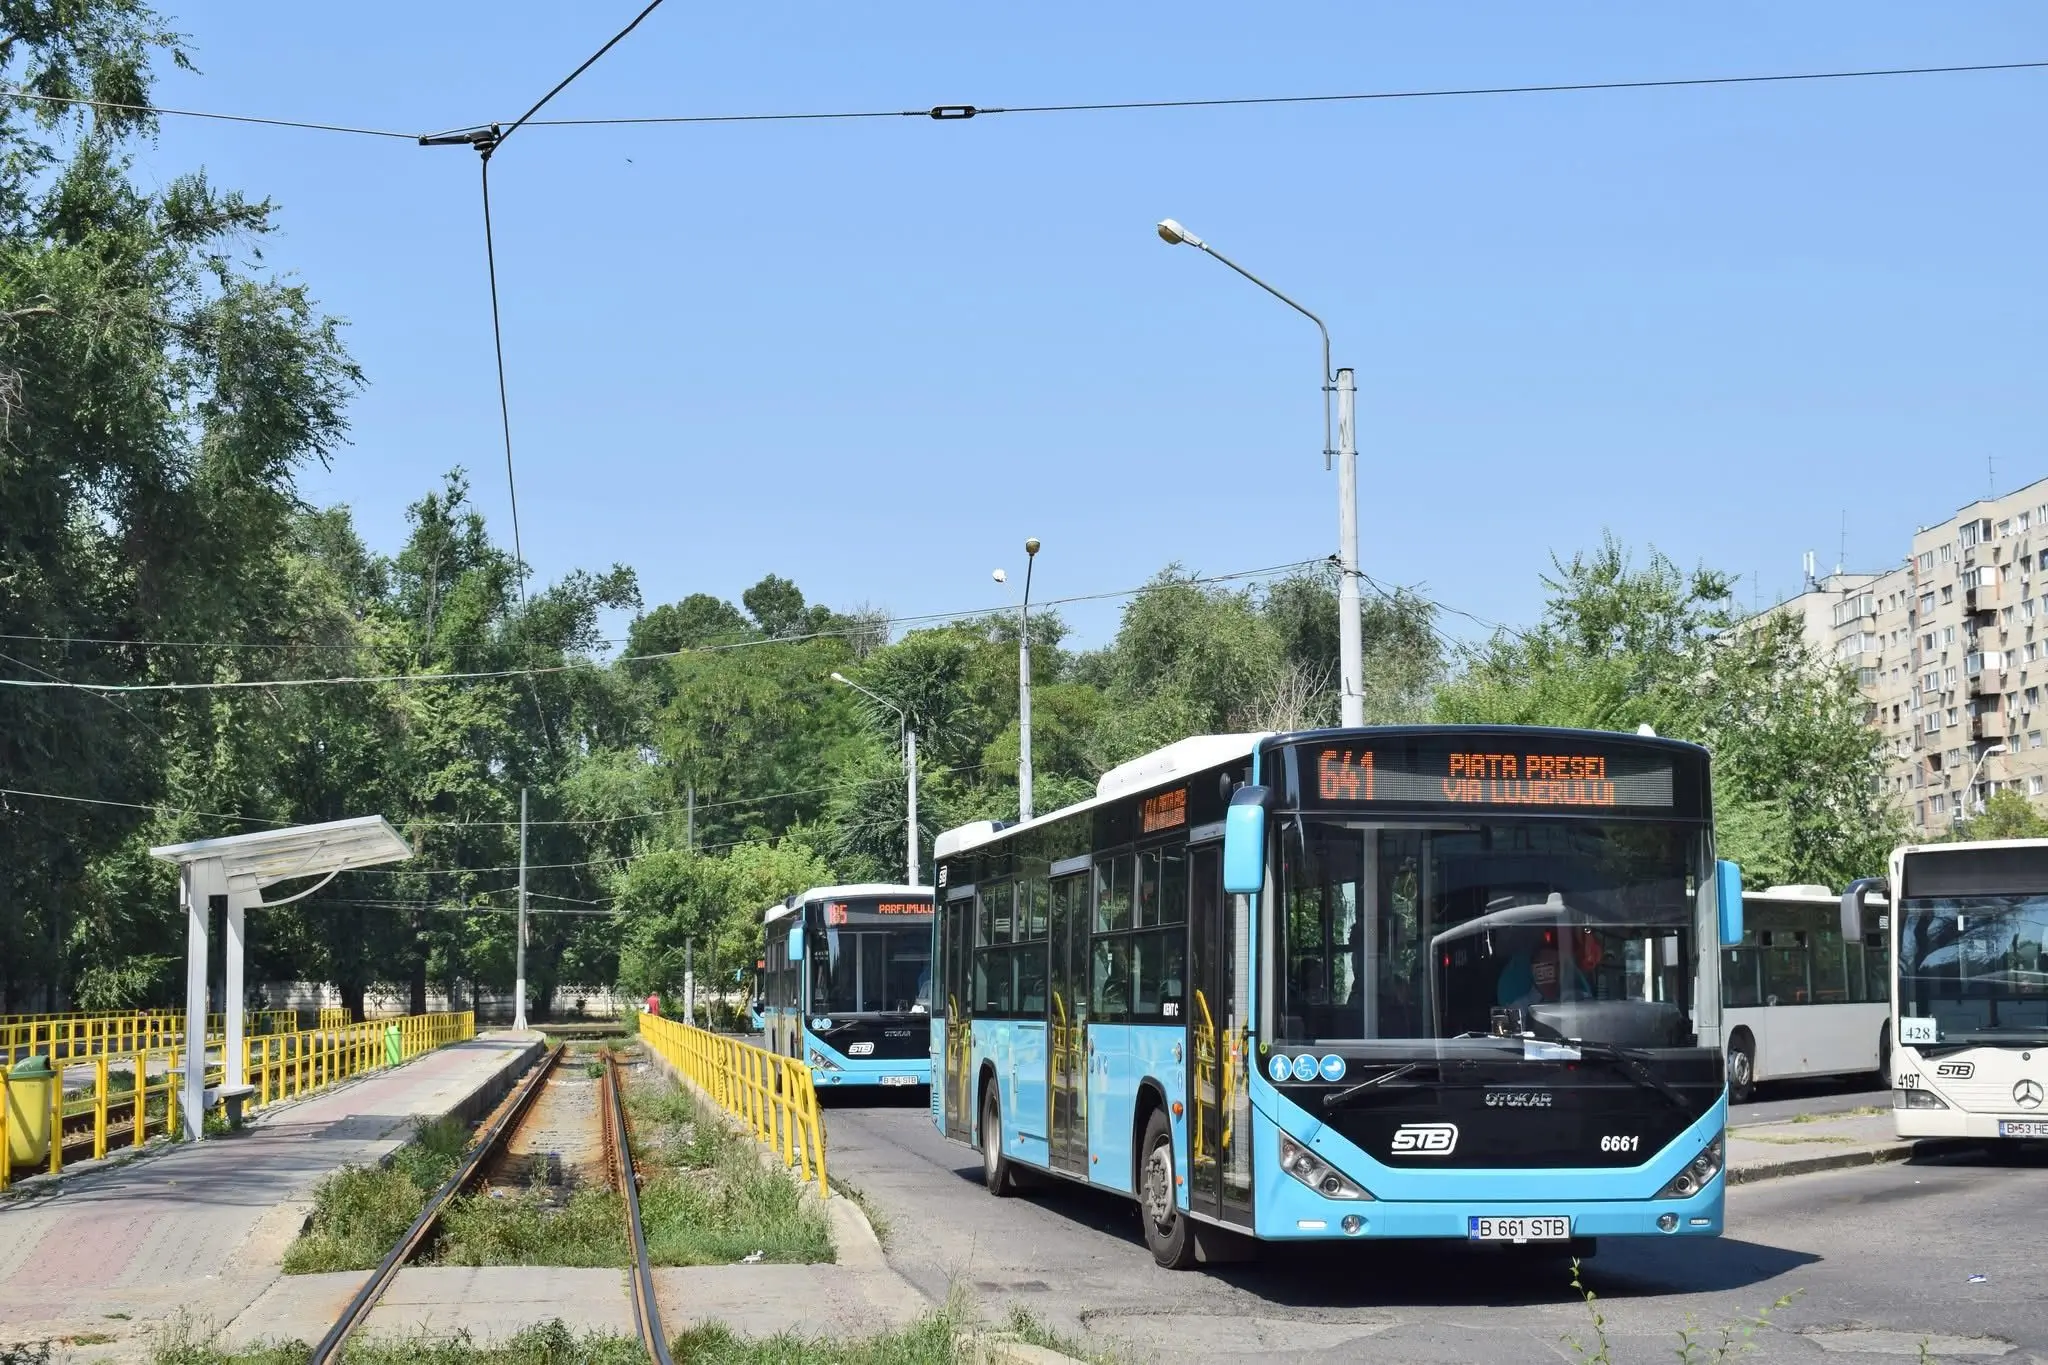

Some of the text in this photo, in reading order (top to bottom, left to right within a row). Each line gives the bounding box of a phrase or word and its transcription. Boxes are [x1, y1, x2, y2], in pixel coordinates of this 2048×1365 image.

[1320, 750, 1373, 800] 641
[1450, 753, 1605, 780] PIATA PRESEI
[1442, 777, 1615, 805] VIA LUJERULUI
[1905, 1027, 1931, 1040] 428
[1936, 1064, 1972, 1076] STB
[1898, 1073, 1920, 1089] 4197
[1485, 1092, 1552, 1107] OTOKAR
[2007, 1123, 2015, 1134] B
[2018, 1123, 2031, 1134] 53
[1391, 1127, 1453, 1150] STB
[1600, 1135, 1640, 1152] 6661
[1480, 1219, 1565, 1237] B 661 STB
